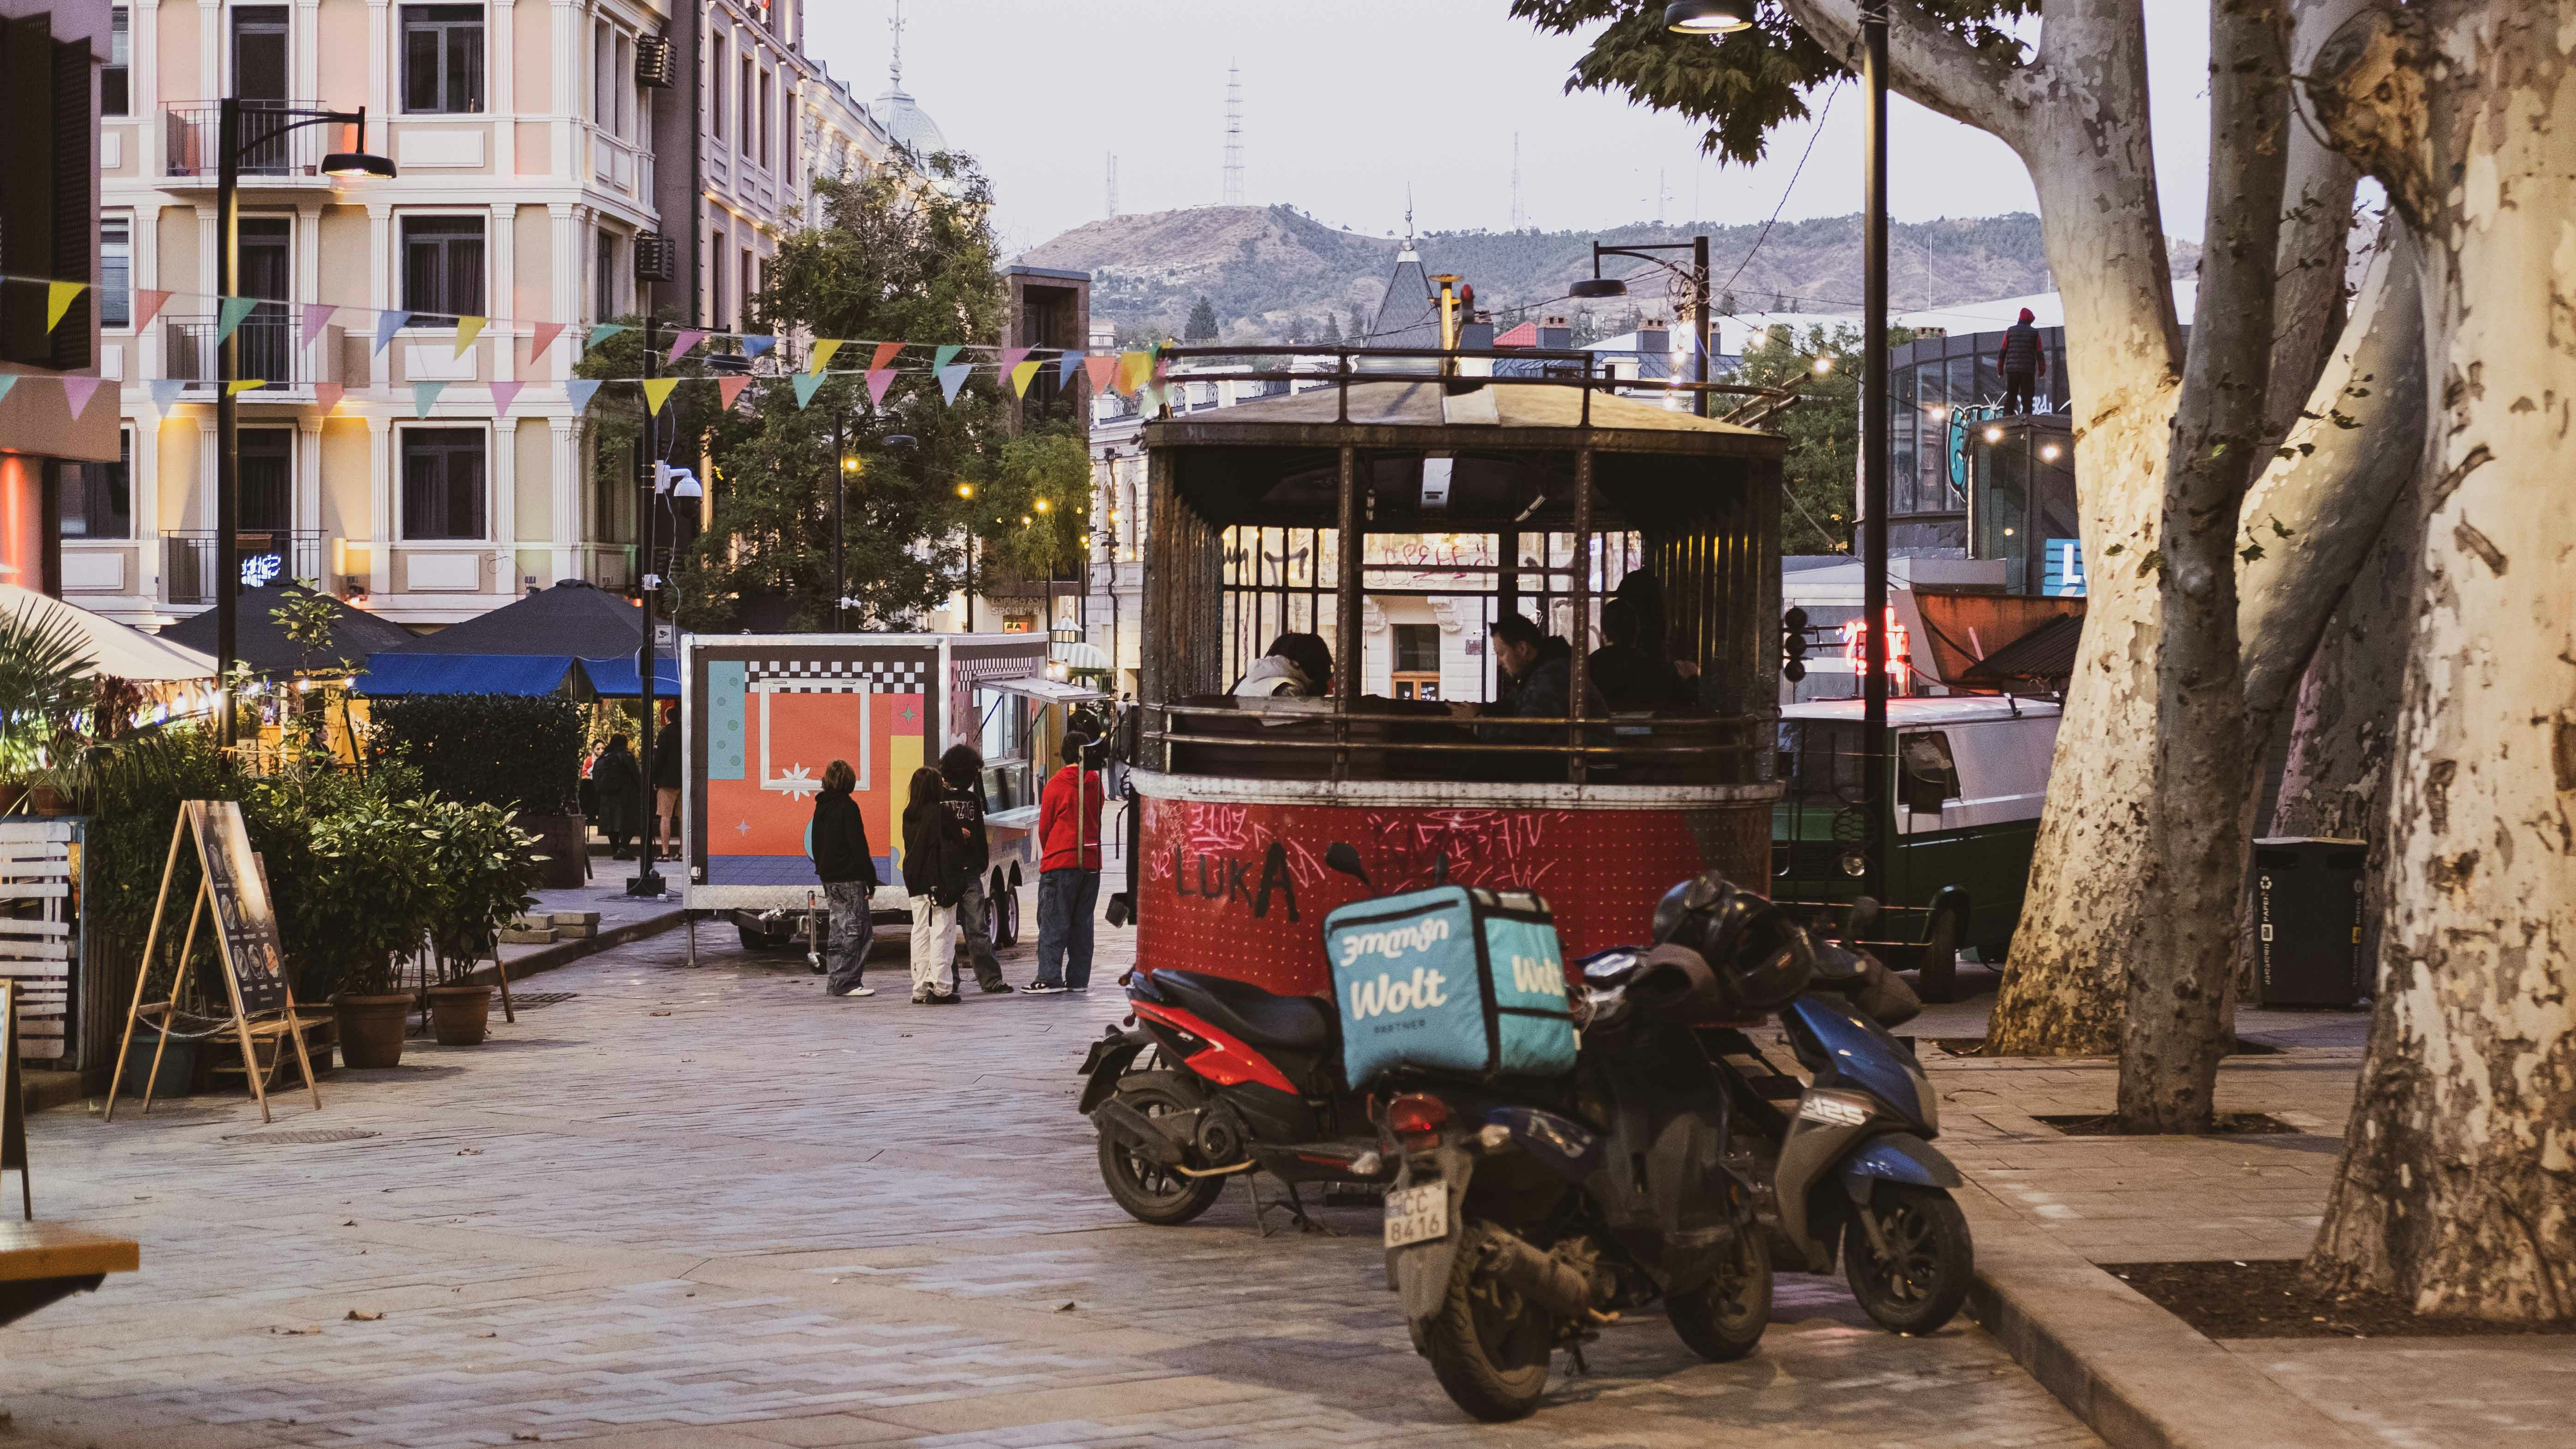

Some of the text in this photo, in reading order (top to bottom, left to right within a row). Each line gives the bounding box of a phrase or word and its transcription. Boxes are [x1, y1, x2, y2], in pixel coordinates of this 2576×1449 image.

[1175, 842, 1300, 922] LUKA
[1350, 968, 1448, 1020] Wolt
[1391, 1215, 1439, 1242] 8416
